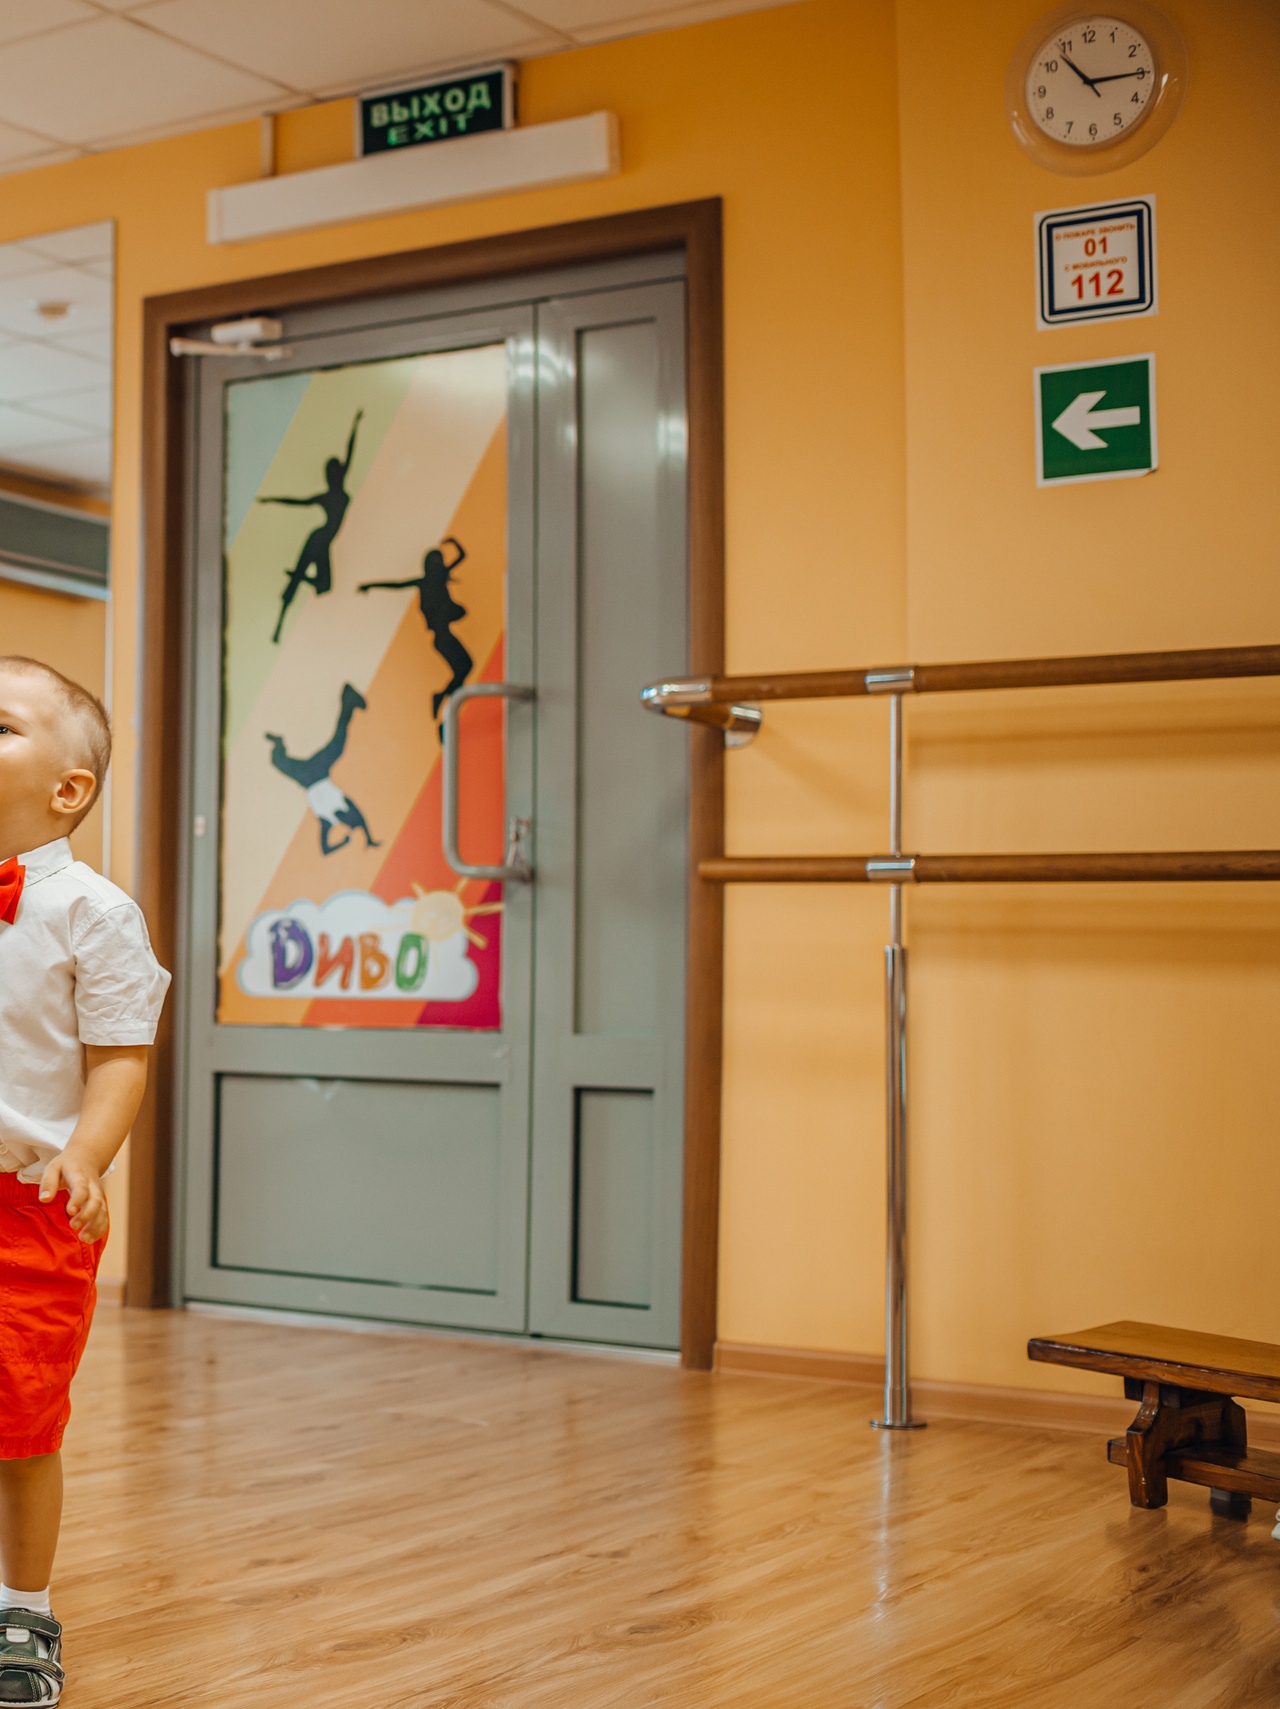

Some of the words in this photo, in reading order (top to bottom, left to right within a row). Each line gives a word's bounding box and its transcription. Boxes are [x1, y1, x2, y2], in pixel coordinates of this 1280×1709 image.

[1082, 30, 1096, 43] 12
[1109, 31, 1116, 43] 1
[1061, 40, 1073, 54] 11
[1128, 45, 1137, 58] 2
[1044, 60, 1059, 73] 10
[1136, 67, 1146, 80] 3
[1038, 85, 1047, 98] 9
[1130, 92, 1139, 104] 4
[371, 81, 492, 128] ВЫХОД
[1046, 107, 1055, 120] 8
[1113, 112, 1122, 126] 5
[387, 113, 468, 145] EXIT
[1066, 121, 1074, 134] 7
[1089, 123, 1098, 136] 6
[1084, 235, 1107, 257] 01
[1071, 269, 1124, 300] 112
